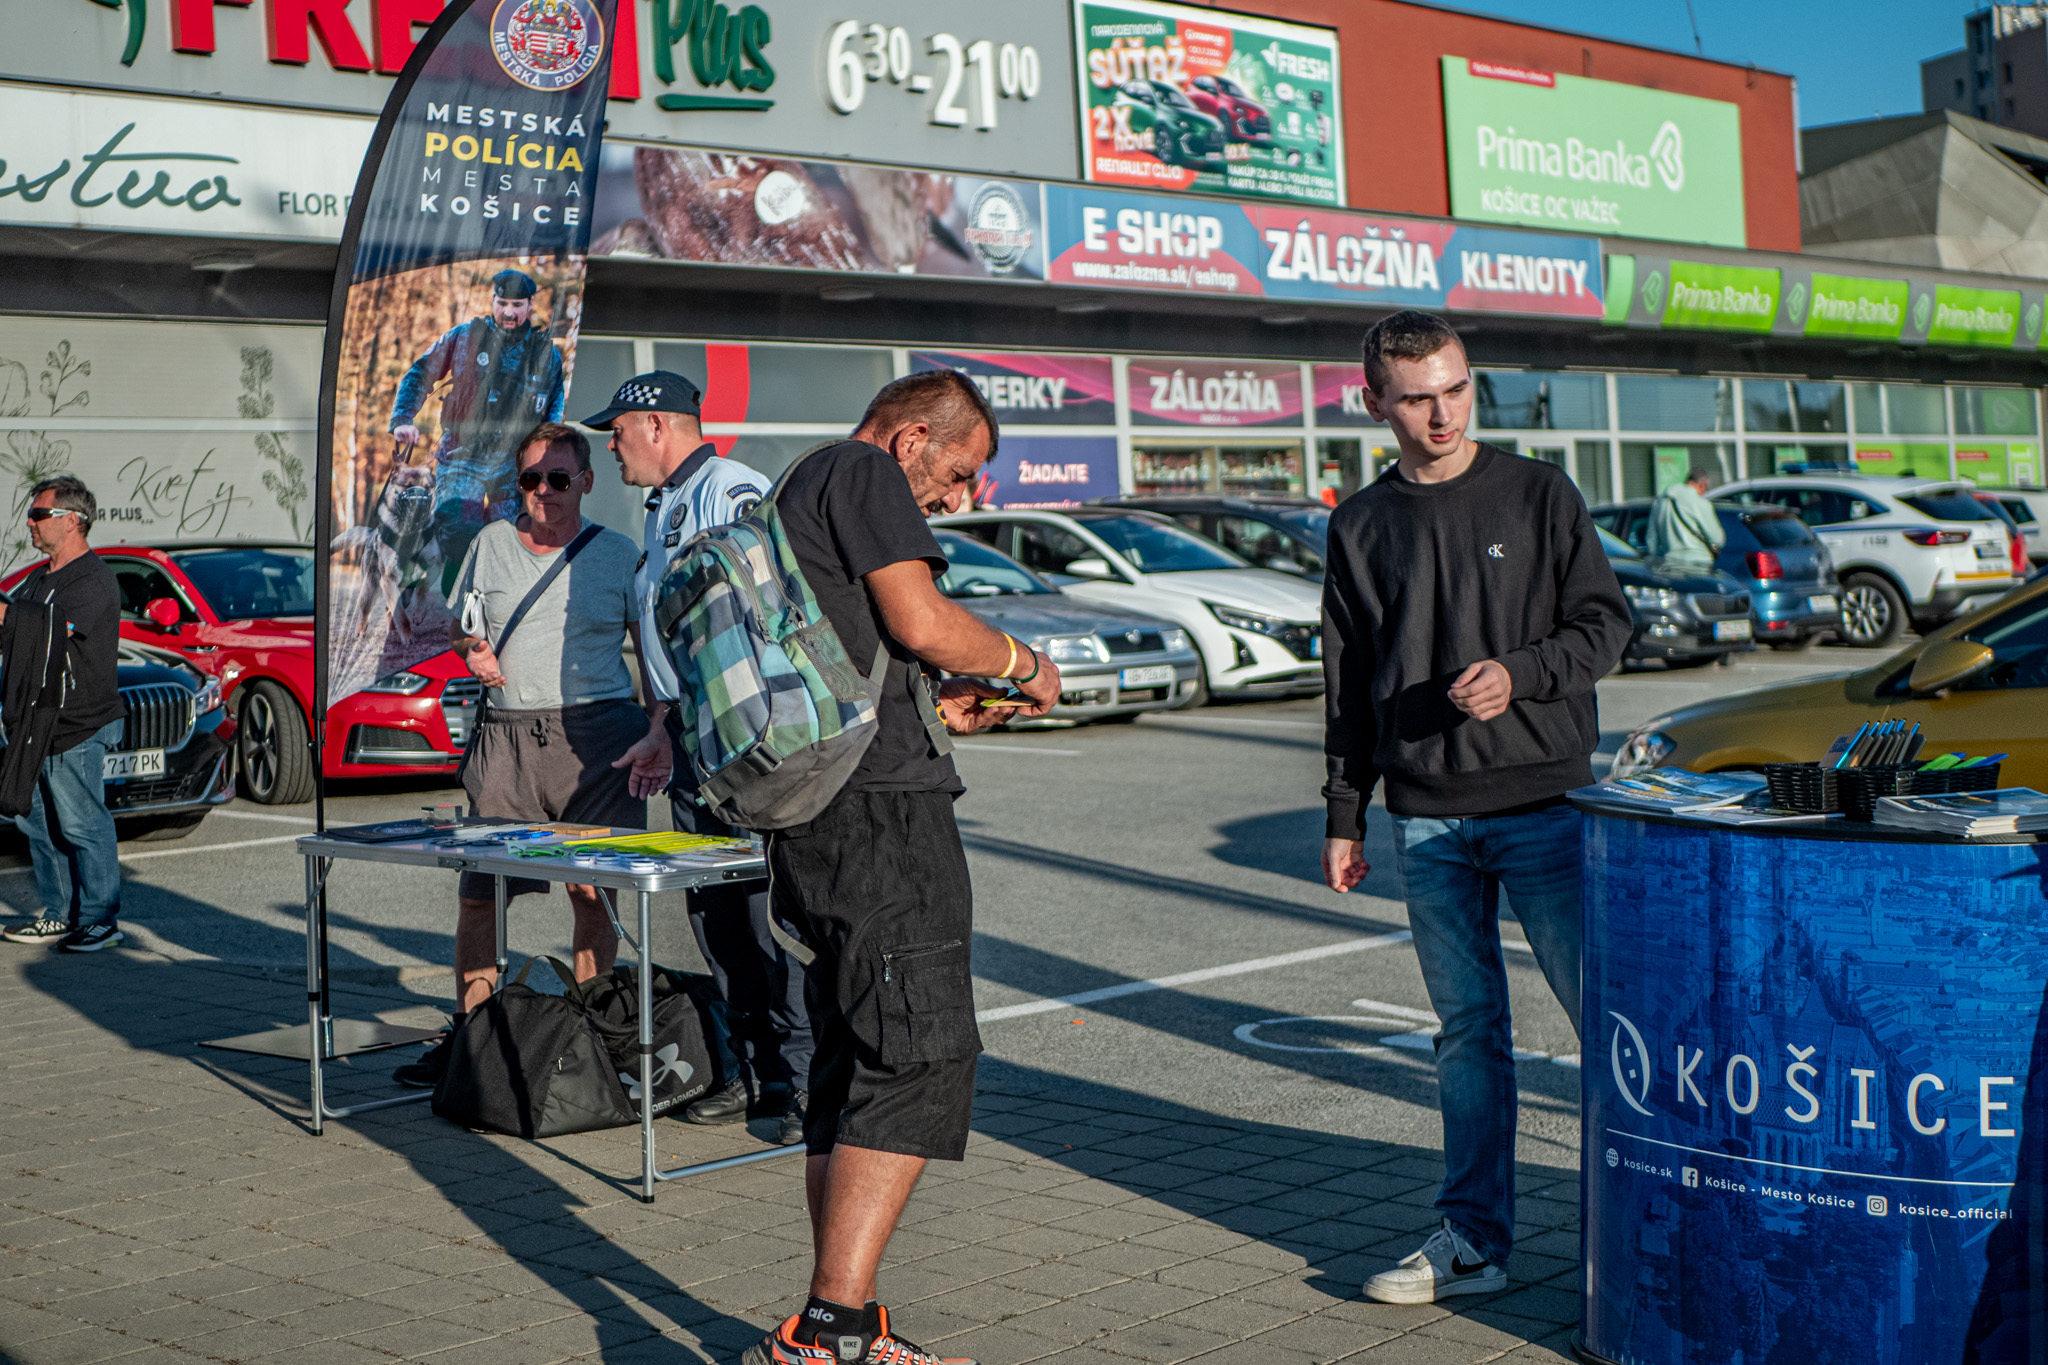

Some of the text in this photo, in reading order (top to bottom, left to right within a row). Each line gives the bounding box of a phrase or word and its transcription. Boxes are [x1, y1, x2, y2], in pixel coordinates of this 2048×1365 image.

[494, 32, 540, 86] MESTSKÁ
[554, 45, 600, 87] POLÍCIA
[1279, 52, 1331, 82] FRESH
[427, 102, 586, 137] MESTSKÁ
[425, 132, 584, 172] POLÍCIA
[1096, 157, 1152, 177] RENAULT
[1152, 163, 1184, 180] CLIO
[422, 166, 581, 197] MESTA
[278, 191, 338, 217] FLOR
[420, 193, 580, 226] KOŠICE
[1481, 186, 1620, 225] KOŠICE OC VAŽEC
[1117, 208, 1223, 260] SHOP
[1265, 219, 1440, 291] ZÁLOŽŇA
[1461, 250, 1588, 297] KLENOTY
[954, 366, 1067, 409] PERKY
[1150, 369, 1281, 412] ZÁLOŽŇA
[1019, 460, 1089, 484] ŽIADAJTE
[110, 506, 142, 521] PLUS
[671, 1084, 704, 1106] ARMOUR
[1676, 1043, 2016, 1137] KOŠICE
[1624, 1157, 1673, 1178] kosice.sk
[1705, 1176, 1746, 1193] Košice
[1761, 1186, 1802, 1202] Mesto
[1808, 1193, 1855, 1208] Košice
[1899, 1203, 2013, 1219] kosice_official
